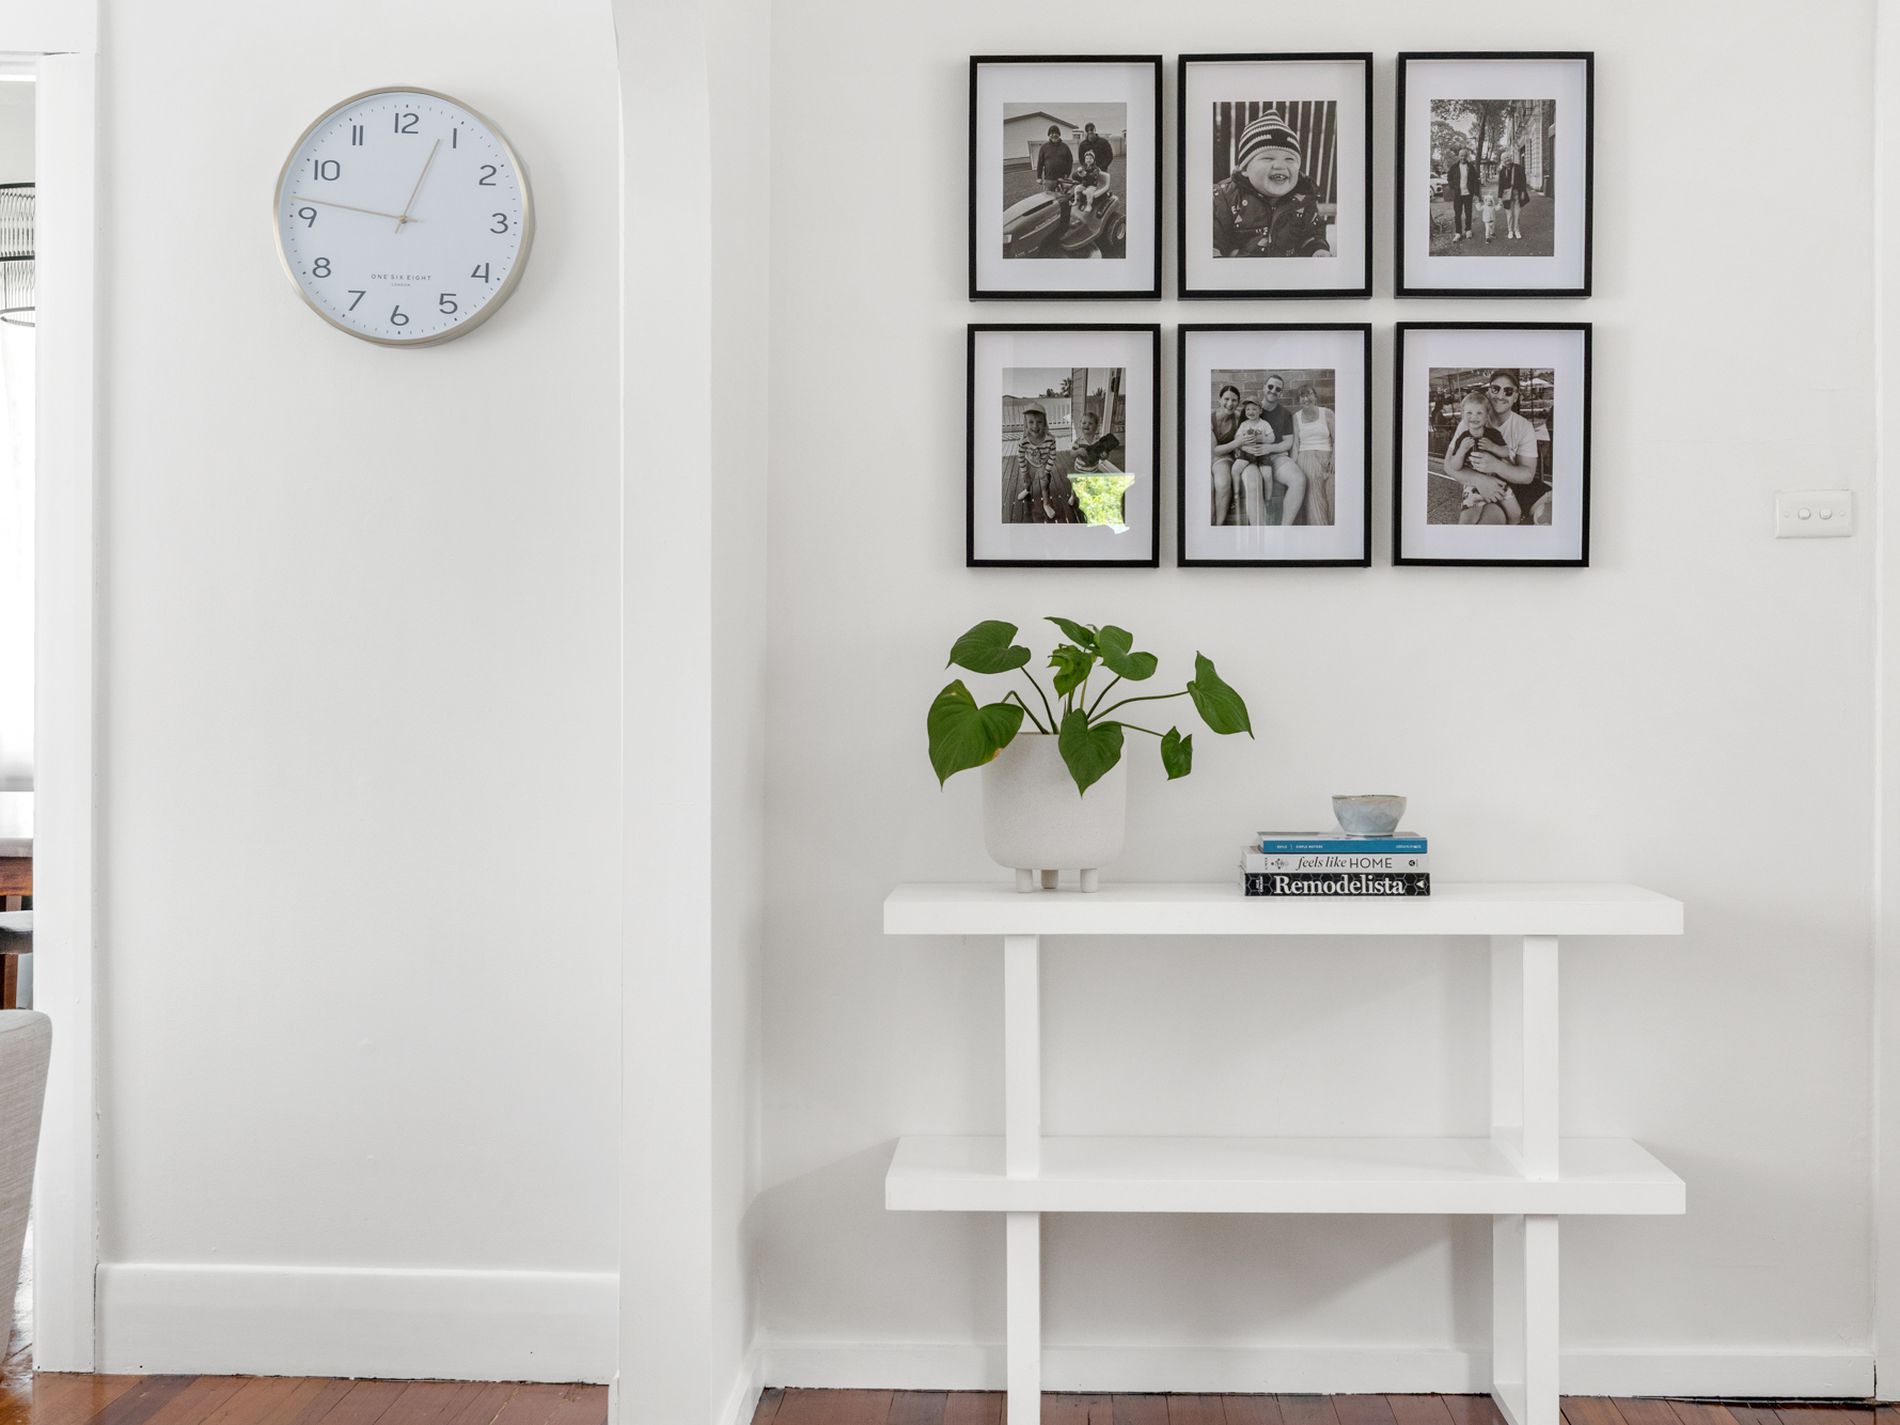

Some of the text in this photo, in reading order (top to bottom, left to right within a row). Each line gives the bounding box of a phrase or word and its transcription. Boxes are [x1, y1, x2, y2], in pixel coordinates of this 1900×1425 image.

[394, 112, 420, 134] 12
[351, 124, 364, 146] 11
[452, 127, 458, 149] 1
[313, 159, 341, 181] 10
[478, 164, 497, 186] 2
[297, 206, 317, 228] 9
[490, 212, 509, 234] 3
[312, 256, 332, 279] 8
[470, 262, 490, 284] 4
[347, 290, 367, 312] 7
[438, 293, 458, 315] 5
[390, 304, 410, 327] 6
[1295, 856, 1393, 871] feels like HOME
[1273, 874, 1406, 895] Remodelista
